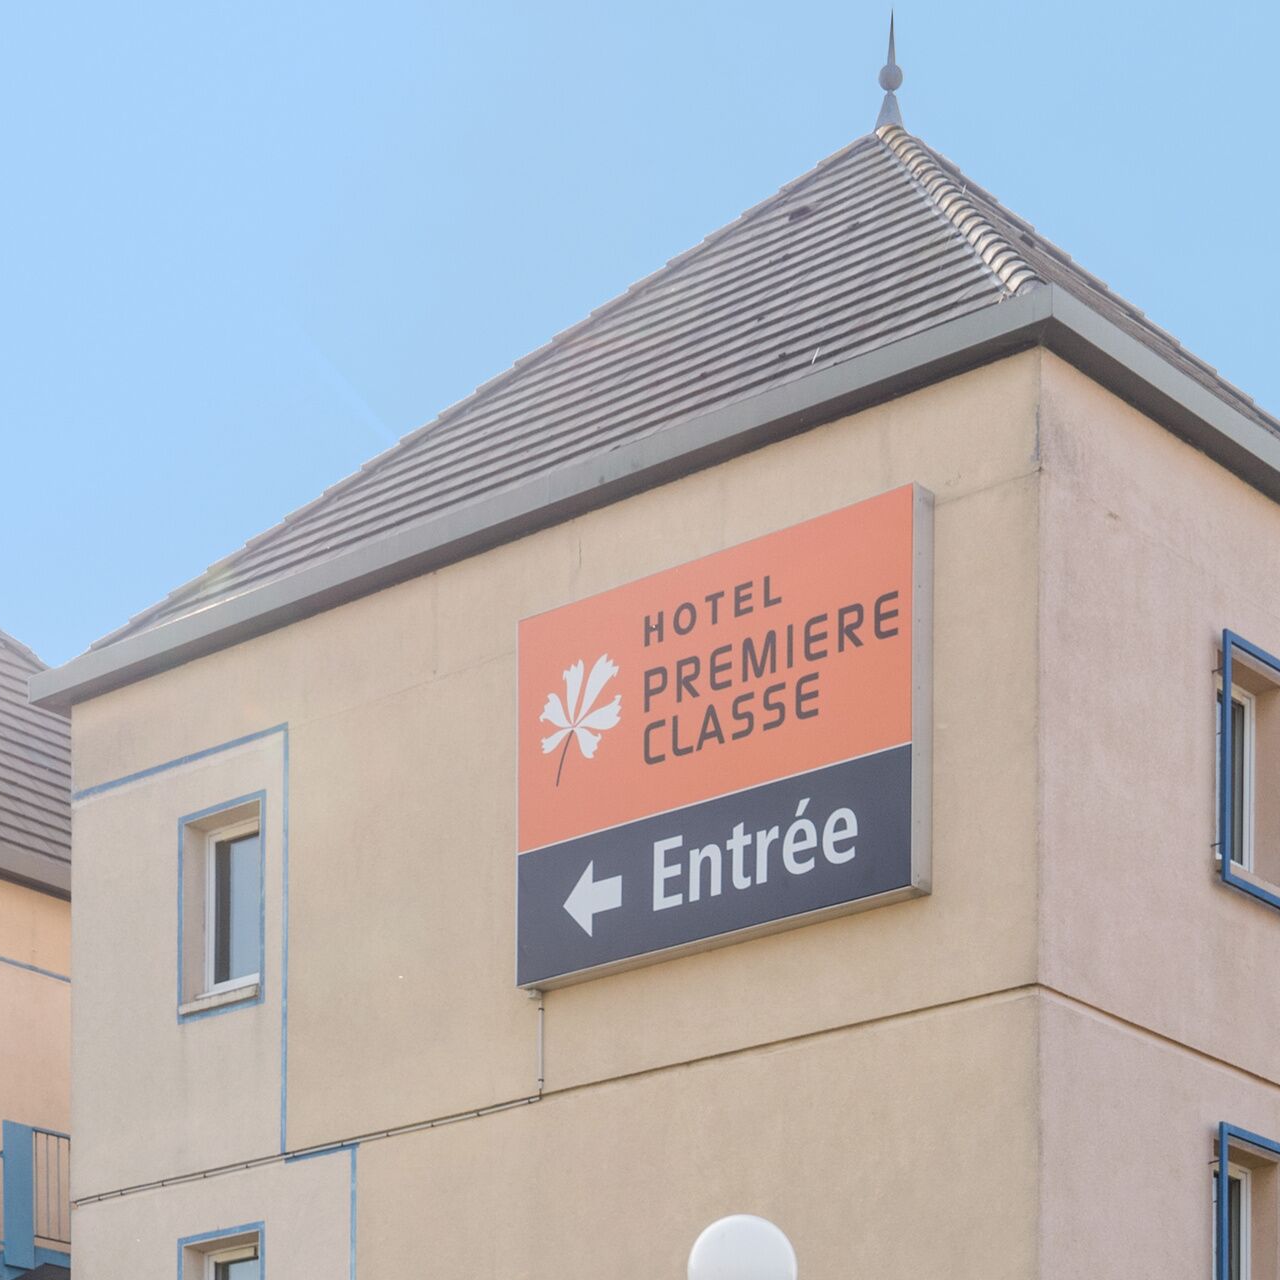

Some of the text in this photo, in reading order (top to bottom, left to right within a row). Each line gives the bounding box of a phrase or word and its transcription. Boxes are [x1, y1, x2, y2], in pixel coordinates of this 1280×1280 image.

[644, 576, 782, 647] HOTEL
[644, 590, 900, 713] PREMIERE
[643, 672, 820, 766] CLASSE
[653, 797, 858, 911] Entrée
